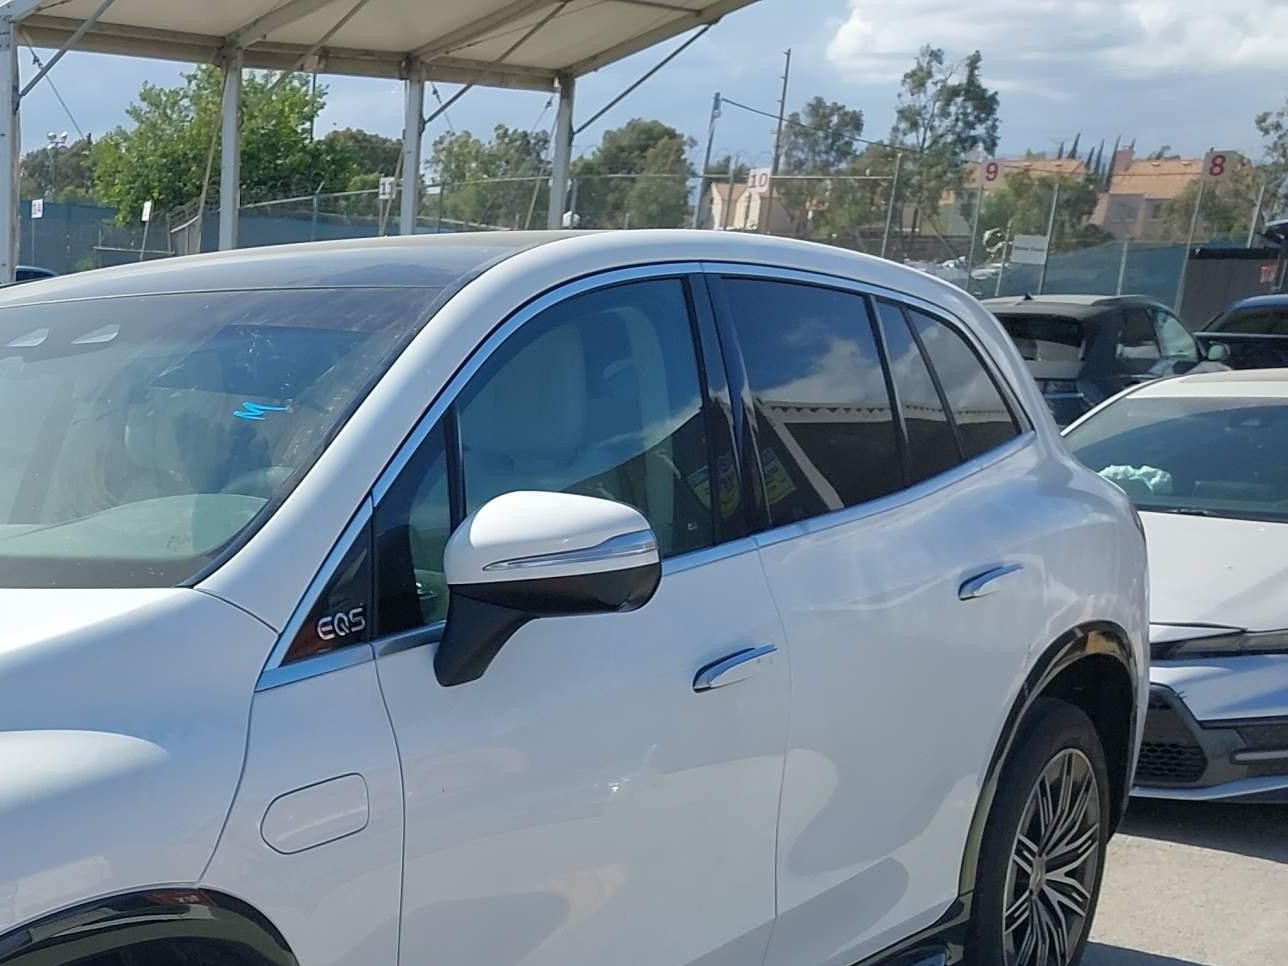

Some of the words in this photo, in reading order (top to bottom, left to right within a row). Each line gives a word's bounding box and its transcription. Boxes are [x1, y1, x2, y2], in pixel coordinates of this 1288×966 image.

[985, 162, 999, 181] 9
[1209, 155, 1226, 176] 8
[749, 172, 769, 188] 10
[317, 607, 365, 640] EQS
